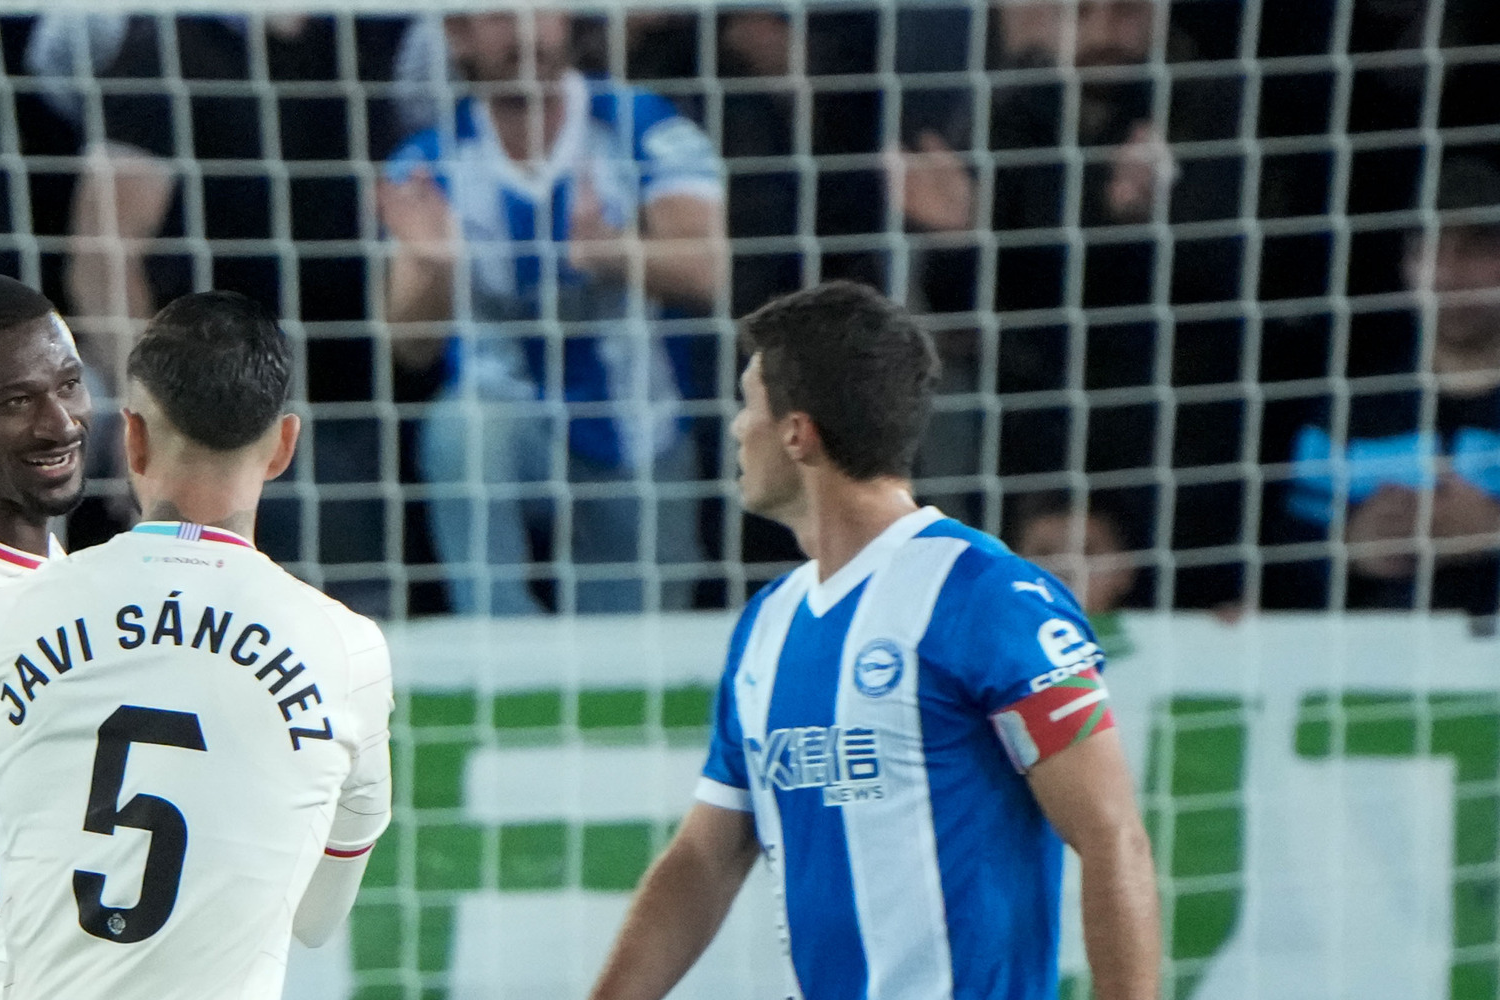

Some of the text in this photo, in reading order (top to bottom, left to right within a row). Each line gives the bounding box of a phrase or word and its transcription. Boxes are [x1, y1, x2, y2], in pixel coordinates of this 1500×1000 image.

[0, 590, 334, 751] JAVI SÁNCHEZ
[72, 704, 208, 944] 5
